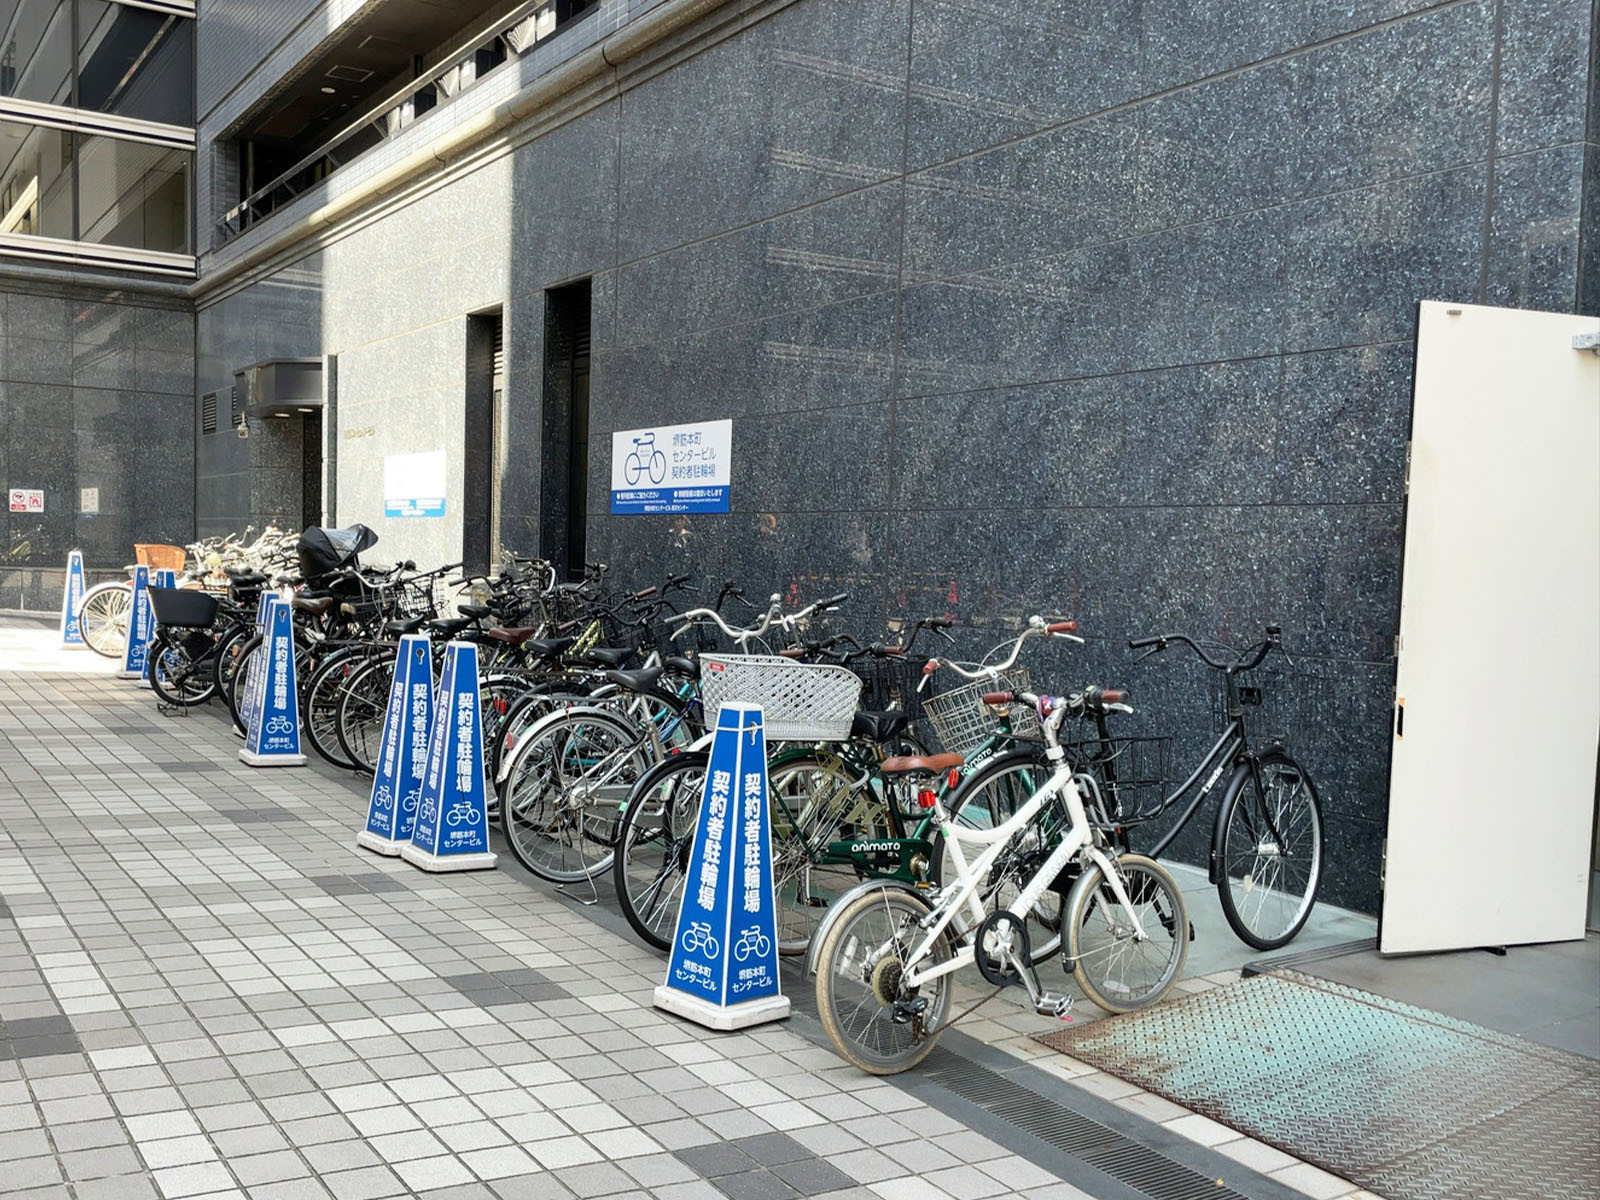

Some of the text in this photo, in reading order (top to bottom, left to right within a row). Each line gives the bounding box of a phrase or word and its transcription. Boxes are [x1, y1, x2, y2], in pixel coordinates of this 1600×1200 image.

[673, 447, 716, 462] センタービル
[672, 464, 715, 479] 契約者駐輪場
[274, 636, 289, 710] 契約者駐輪場
[456, 693, 473, 792] 契約者駐輪場
[443, 838, 482, 848] センタービル
[697, 770, 730, 911] 契約者駐輪場
[744, 773, 761, 912] 契約者駐輪場
[675, 968, 717, 991] センタービル
[732, 976, 773, 993] センタービル
